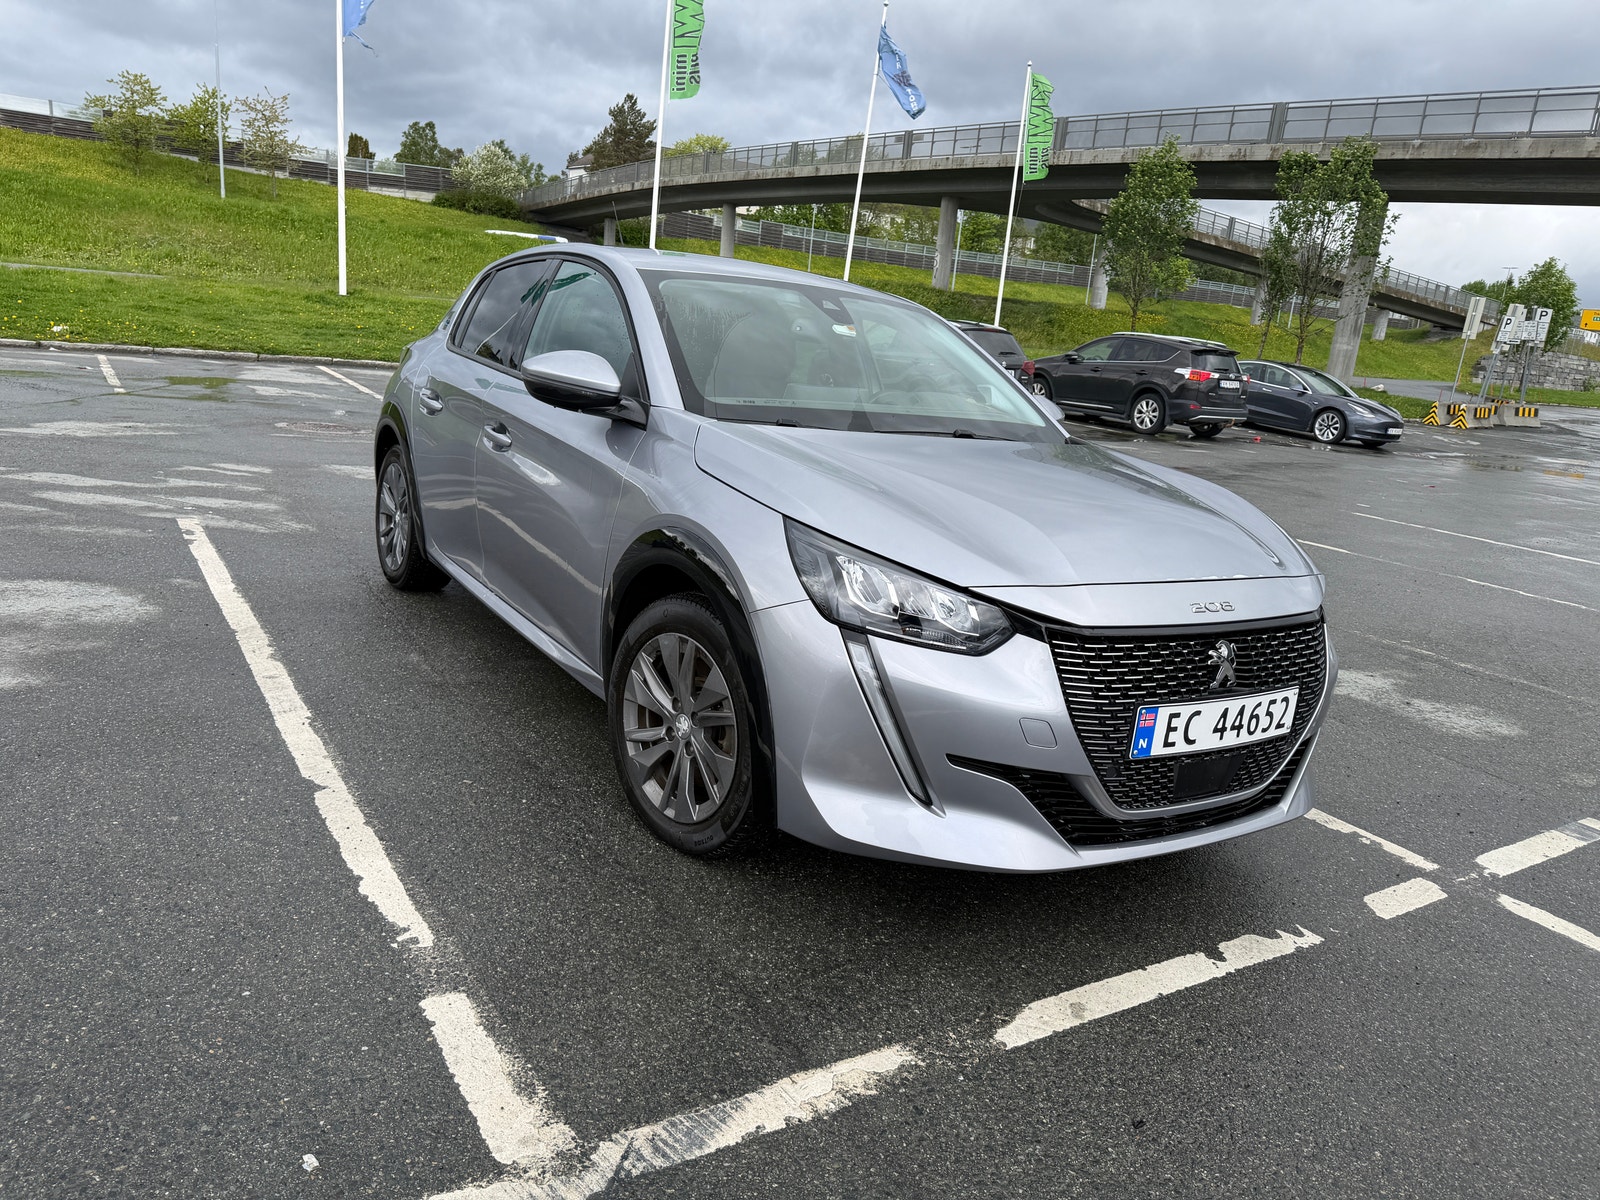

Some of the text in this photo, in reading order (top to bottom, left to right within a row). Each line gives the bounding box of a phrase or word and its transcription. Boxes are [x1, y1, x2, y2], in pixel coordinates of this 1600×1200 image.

[1539, 310, 1549, 321] P
[1503, 317, 1513, 330] P
[1190, 602, 1235, 613] 208
[1138, 696, 1290, 749] N EC 44652
